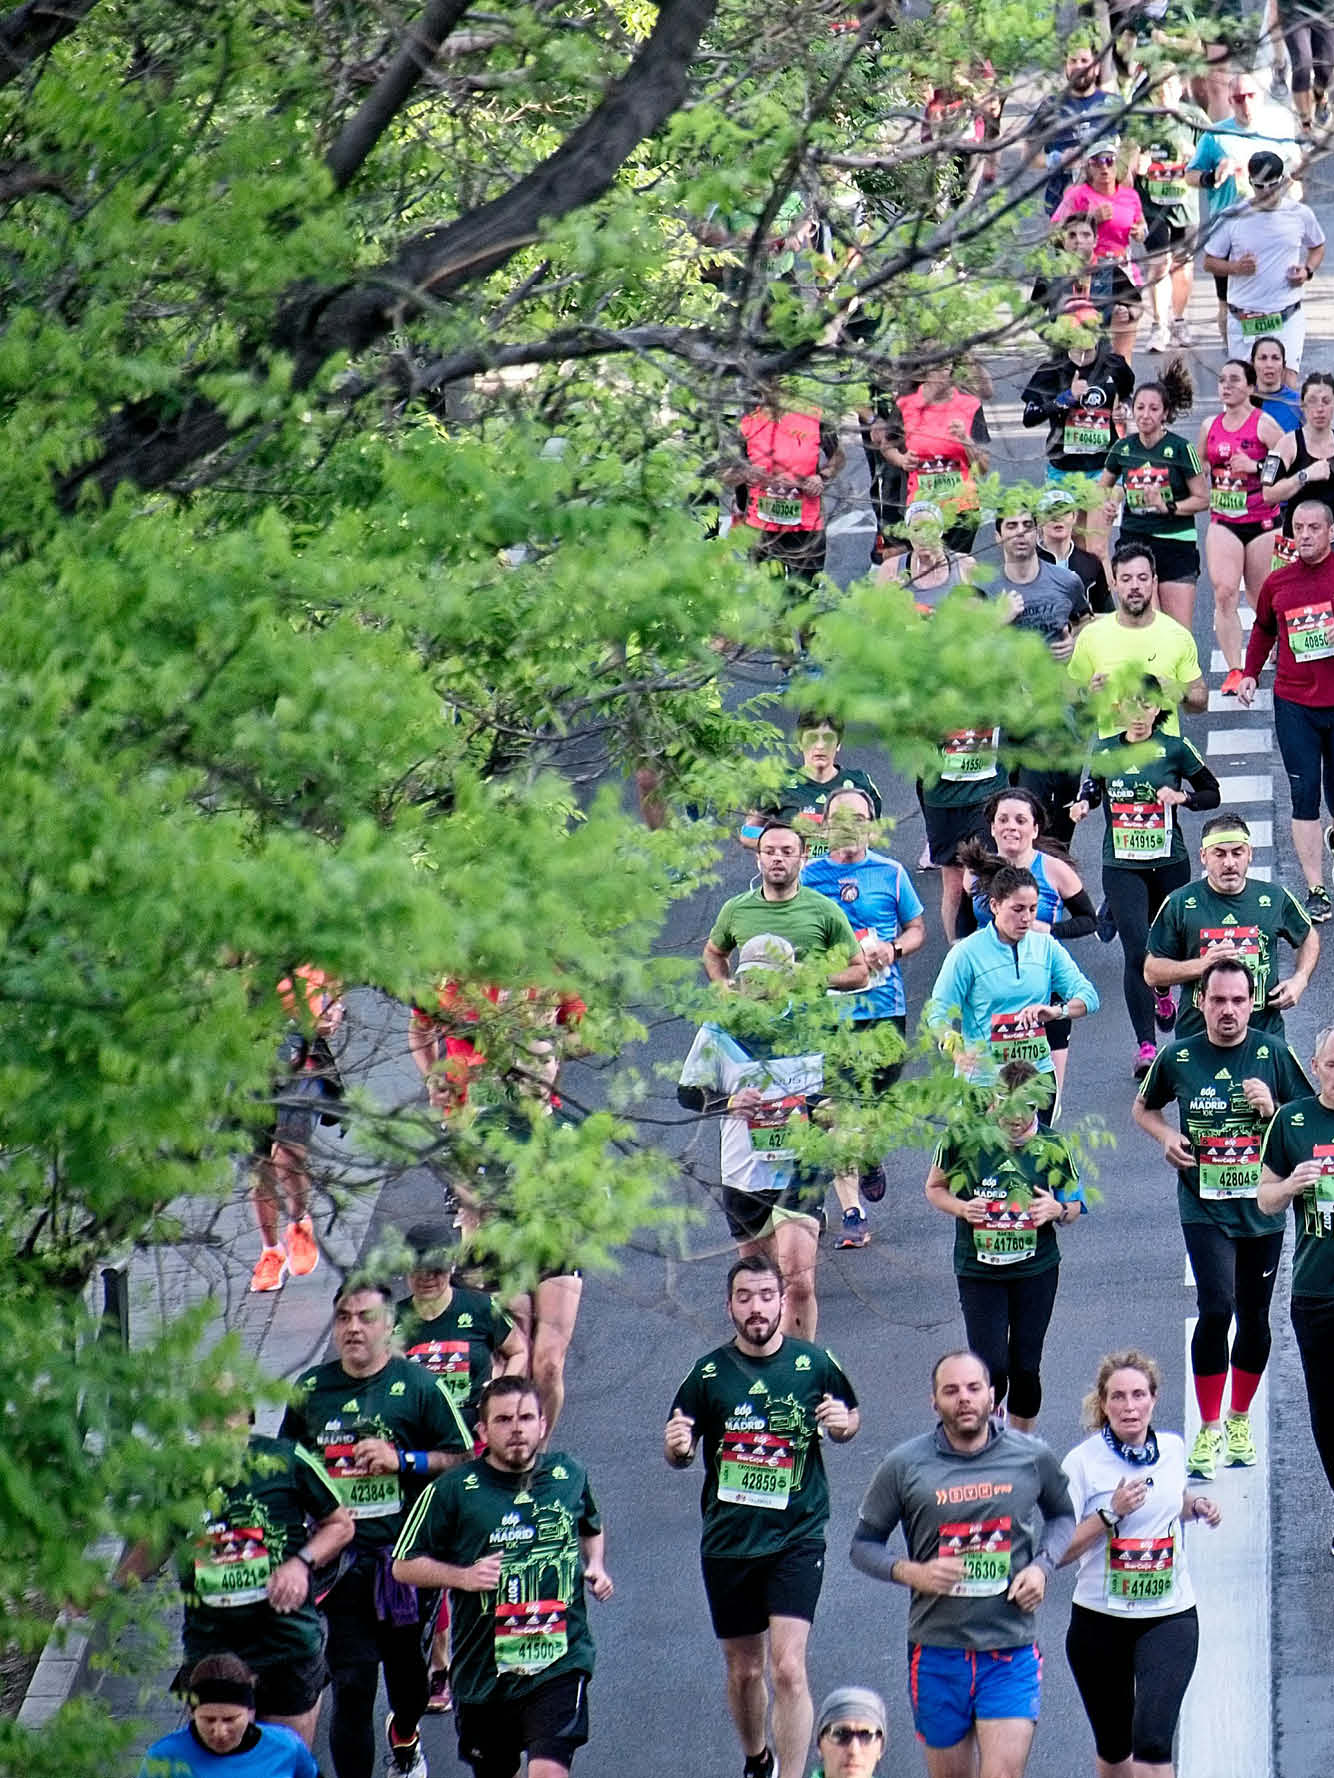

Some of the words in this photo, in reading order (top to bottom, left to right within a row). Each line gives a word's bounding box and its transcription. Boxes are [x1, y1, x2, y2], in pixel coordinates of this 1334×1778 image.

[1200, 1087, 1216, 1098] edp
[1189, 1101, 1227, 1111] MADRID
[1224, 1139, 1236, 1147] edp
[982, 1178, 997, 1187] edp
[1219, 1172, 1250, 1187] 42804
[973, 1188, 1007, 1198] MADRID
[734, 1402, 752, 1417] edp
[725, 1420, 765, 1431] MADRID
[741, 1474, 777, 1492] 42859
[350, 1484, 386, 1504] 42384
[501, 1511, 520, 1526] edp
[489, 1526, 534, 1543] MADRID
[964, 1561, 997, 1580] 2630
[221, 1570, 257, 1591] 40821
[508, 1576, 520, 1602] 2017
[517, 1643, 554, 1659] 41500
